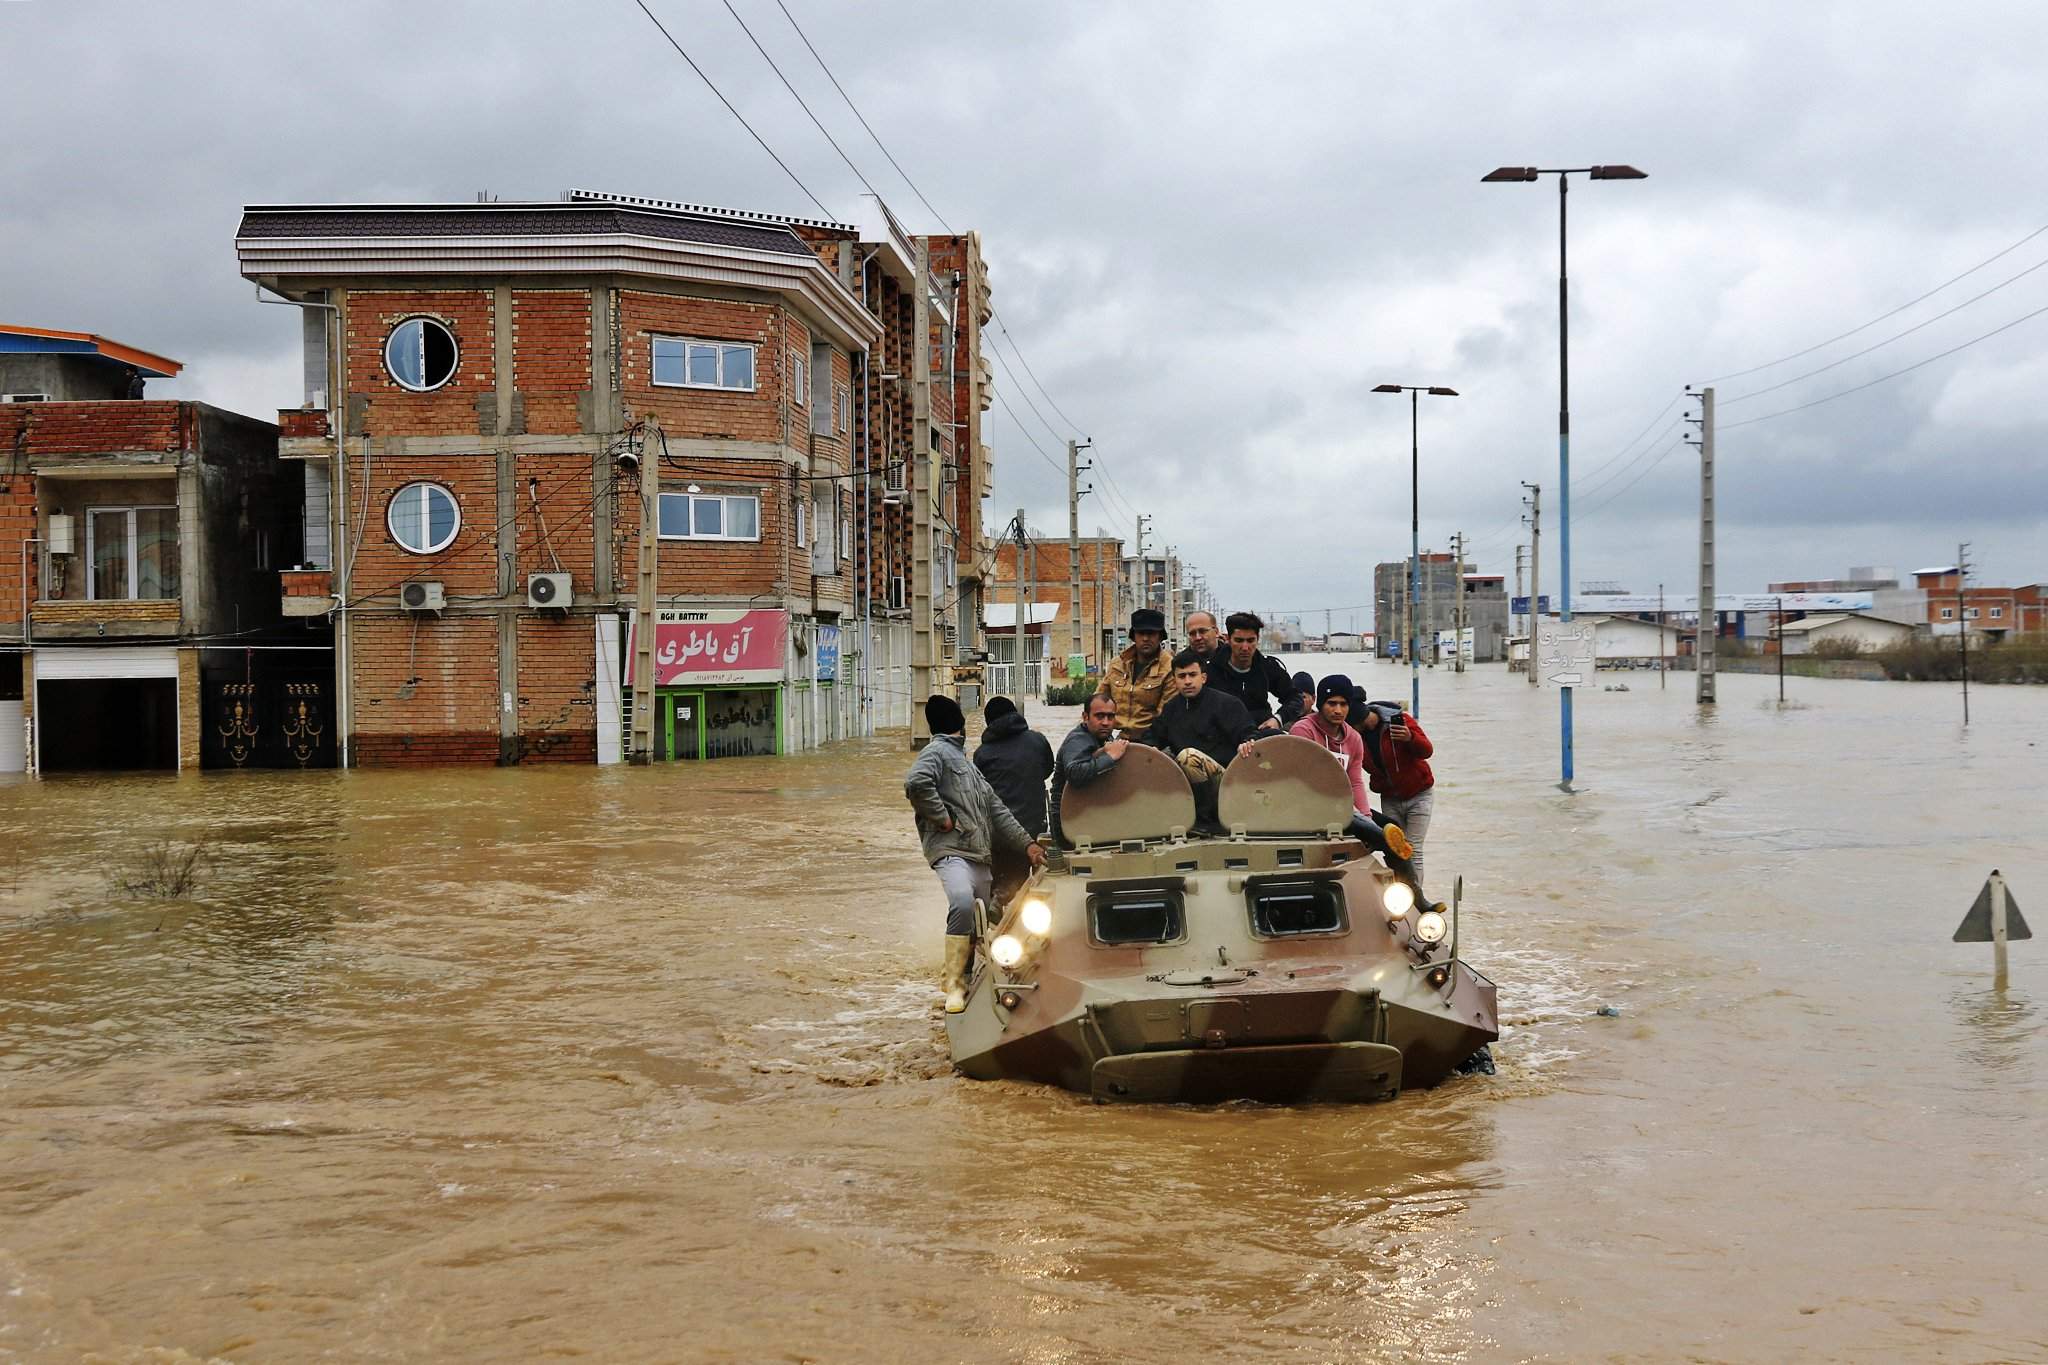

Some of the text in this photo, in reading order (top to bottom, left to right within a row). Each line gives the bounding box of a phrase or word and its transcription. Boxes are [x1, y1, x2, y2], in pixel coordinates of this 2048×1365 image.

[661, 613, 675, 621] AGH
[657, 627, 753, 665] آق باطری
[1539, 649, 1592, 669] فروشی
